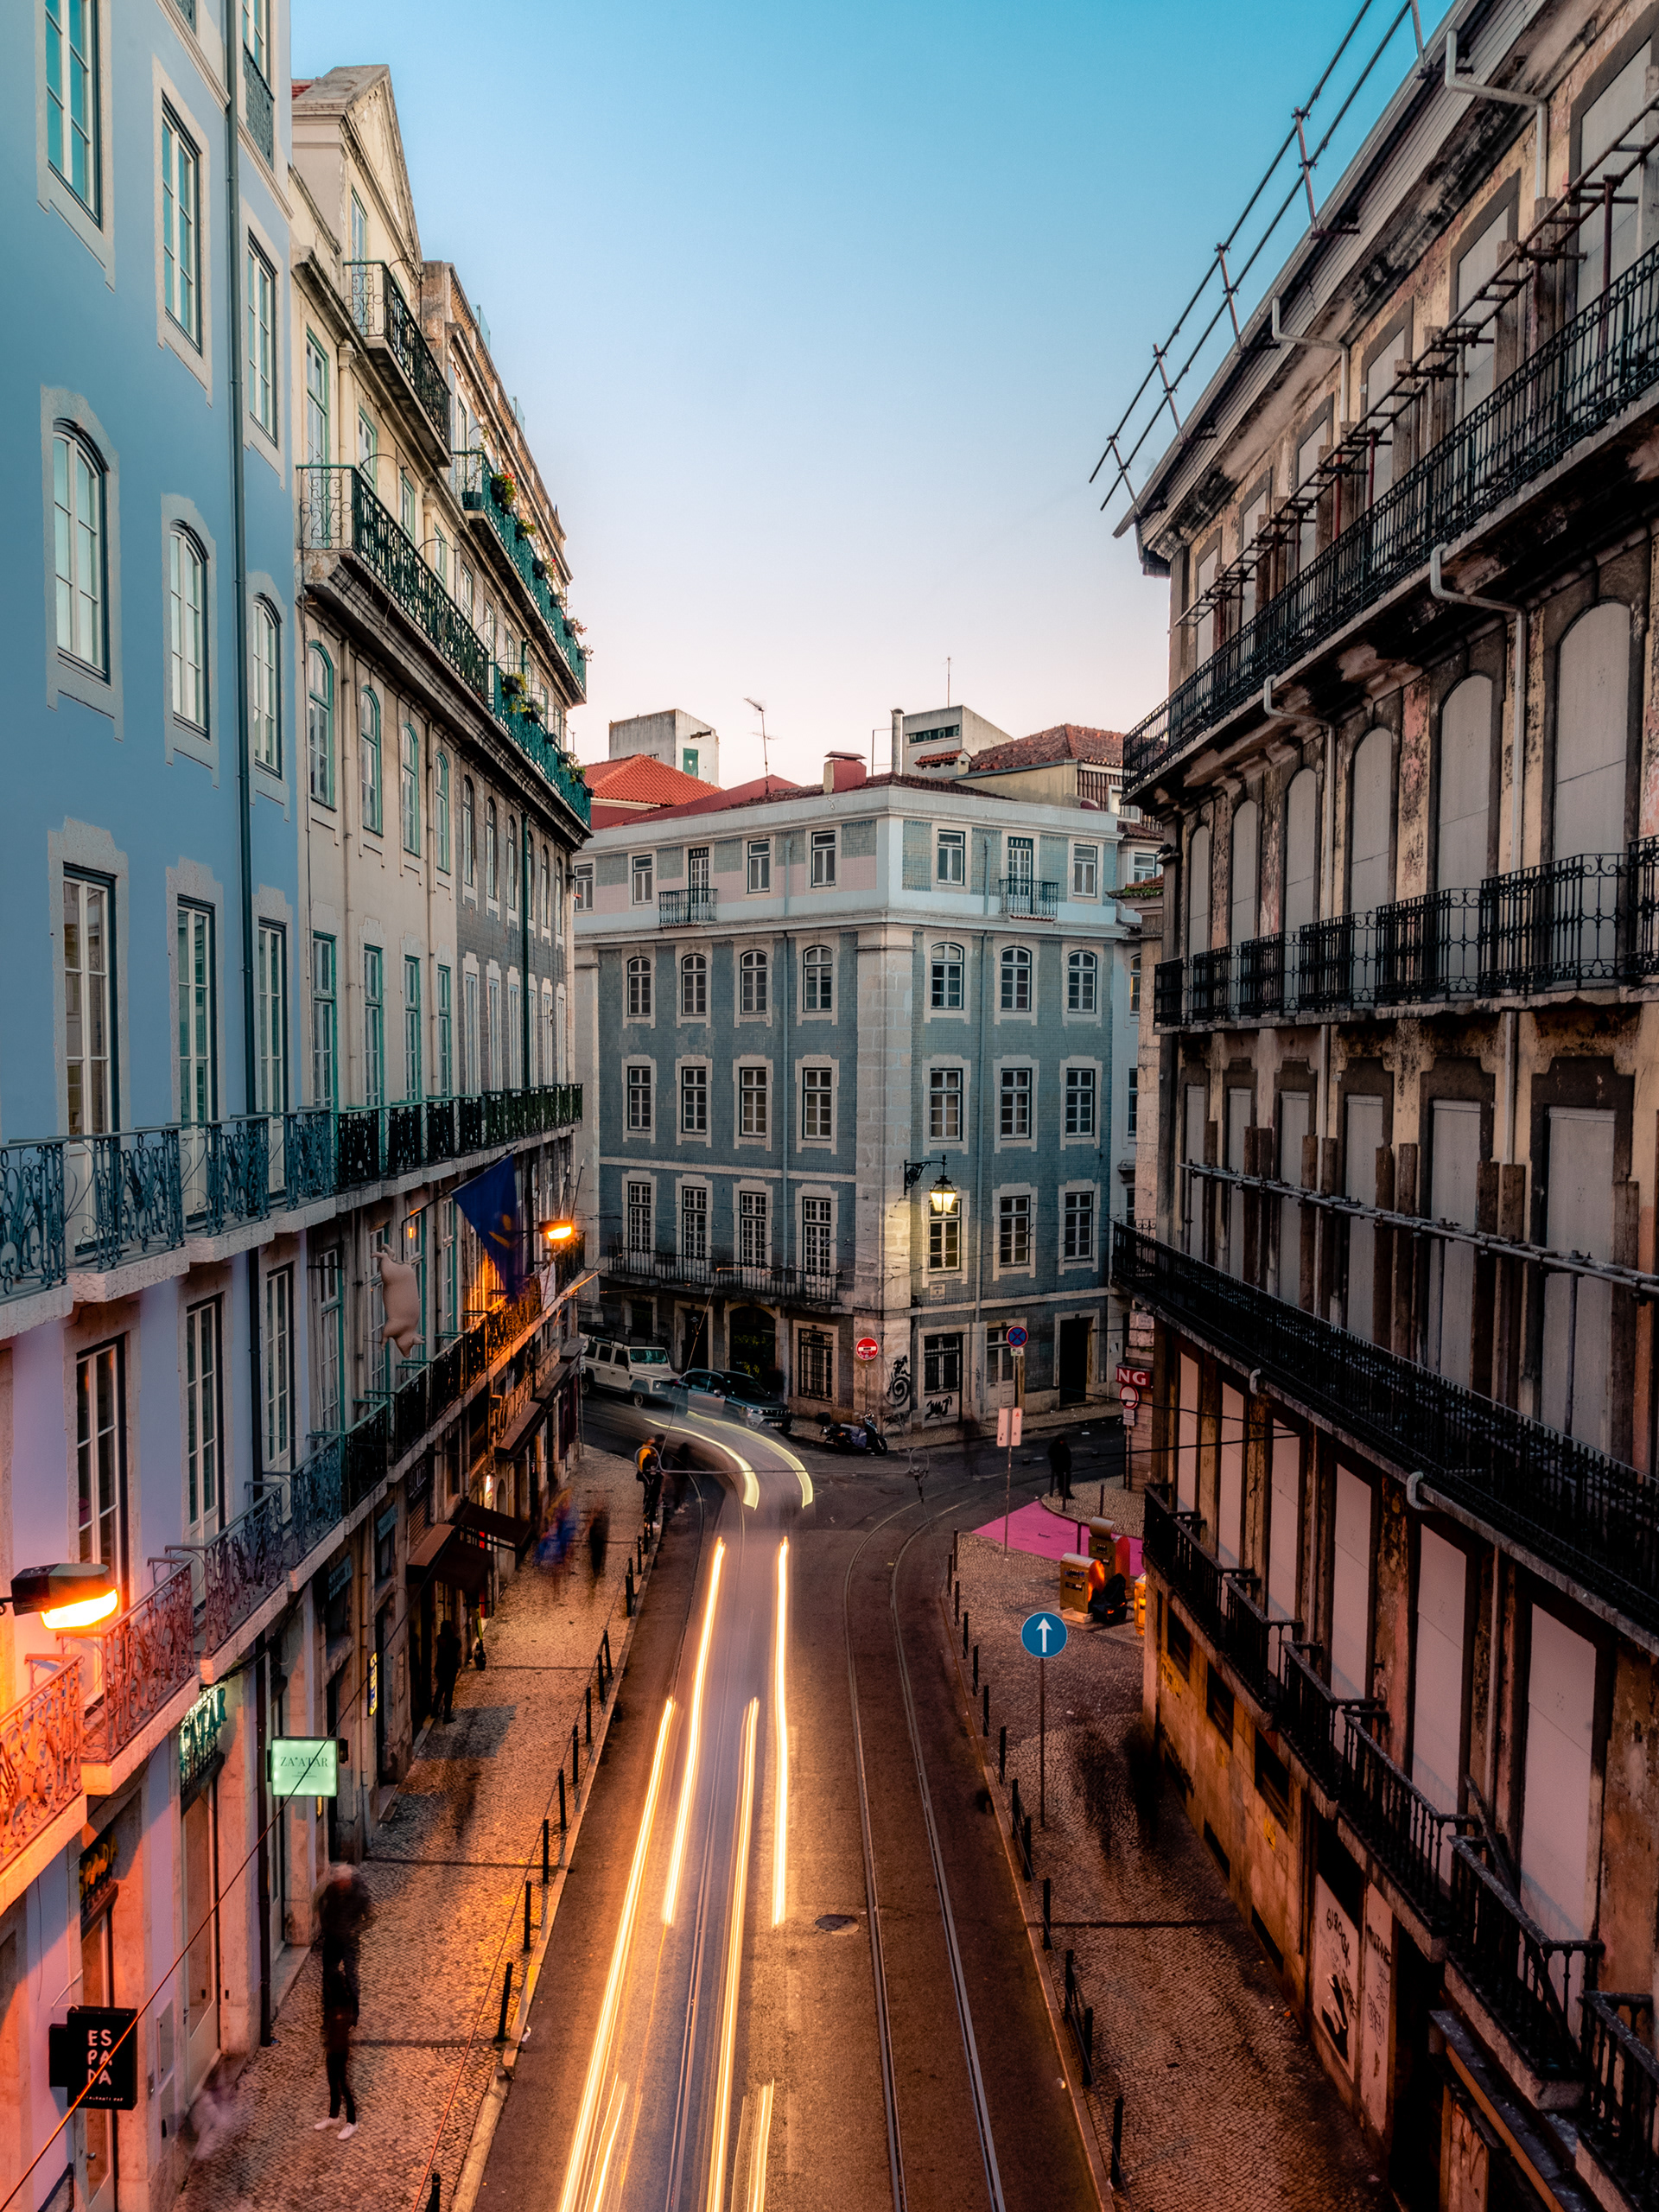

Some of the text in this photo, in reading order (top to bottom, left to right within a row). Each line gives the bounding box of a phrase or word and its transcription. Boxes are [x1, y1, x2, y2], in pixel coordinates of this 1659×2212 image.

[1118, 1368, 1147, 1386] NG
[87, 2029, 112, 2047] ES
[87, 2049, 112, 2066] PA
[87, 2069, 112, 2085] DA
